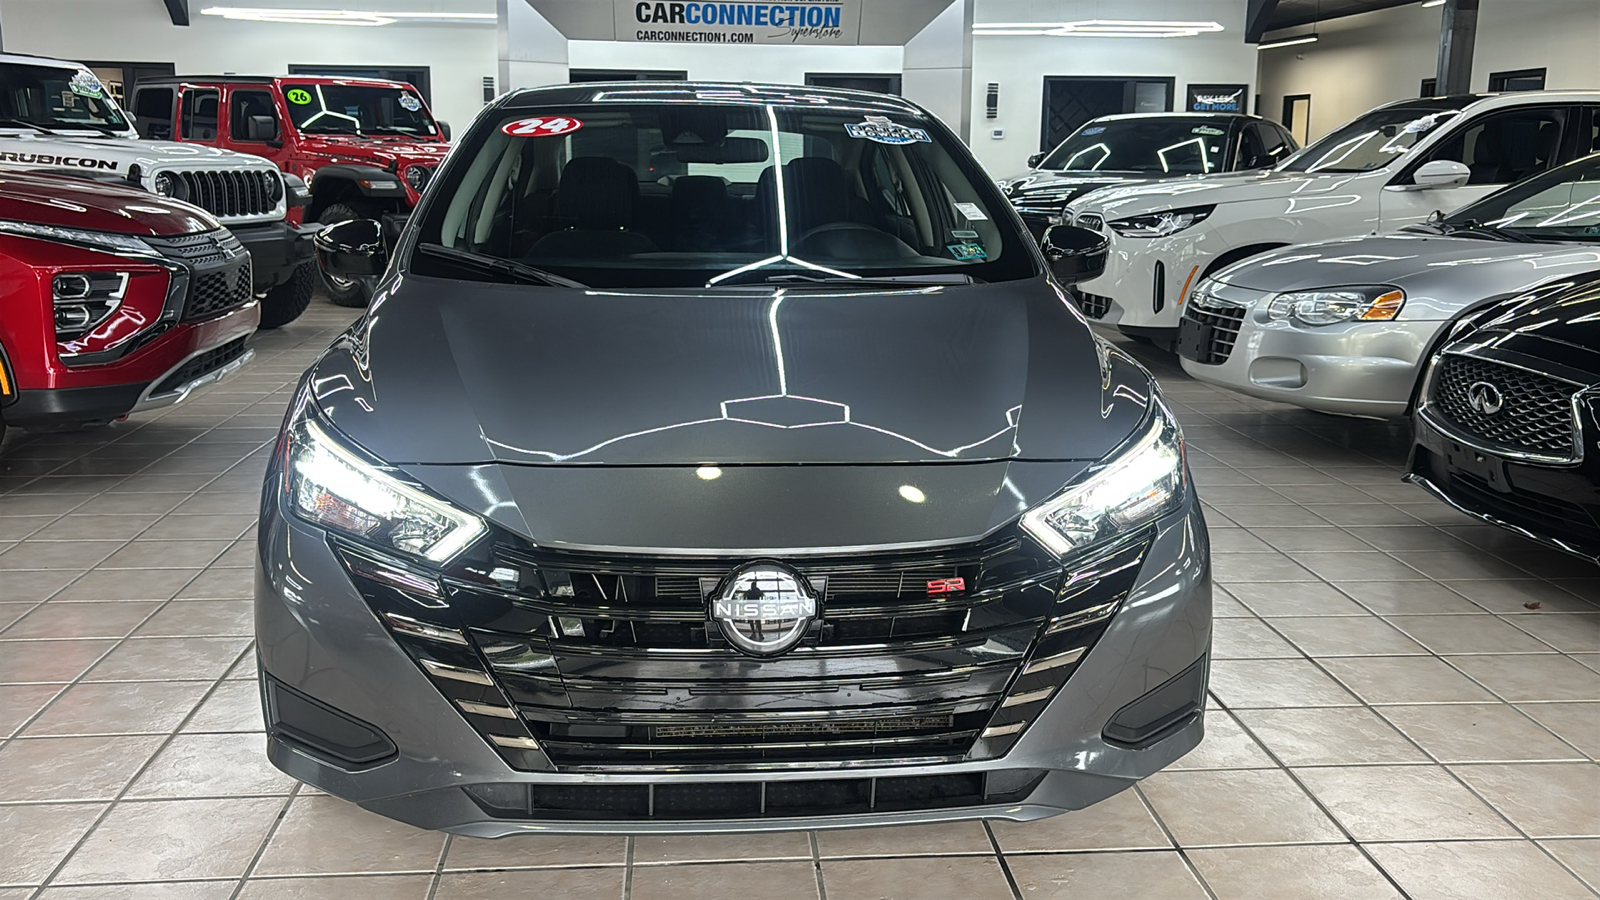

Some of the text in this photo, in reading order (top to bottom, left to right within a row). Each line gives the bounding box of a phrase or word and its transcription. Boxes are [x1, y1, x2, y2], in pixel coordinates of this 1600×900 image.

[635, 2, 840, 28] CARCONNECTION
[636, 30, 754, 43] CARCONNECTION1.COM
[768, 17, 843, 43] Superstore
[292, 92, 307, 101] 26
[1193, 102, 1210, 110] GET
[512, 118, 569, 133] 24
[0, 151, 118, 170] RUBICON
[927, 577, 965, 594] SR
[716, 603, 813, 616] NISSAN
